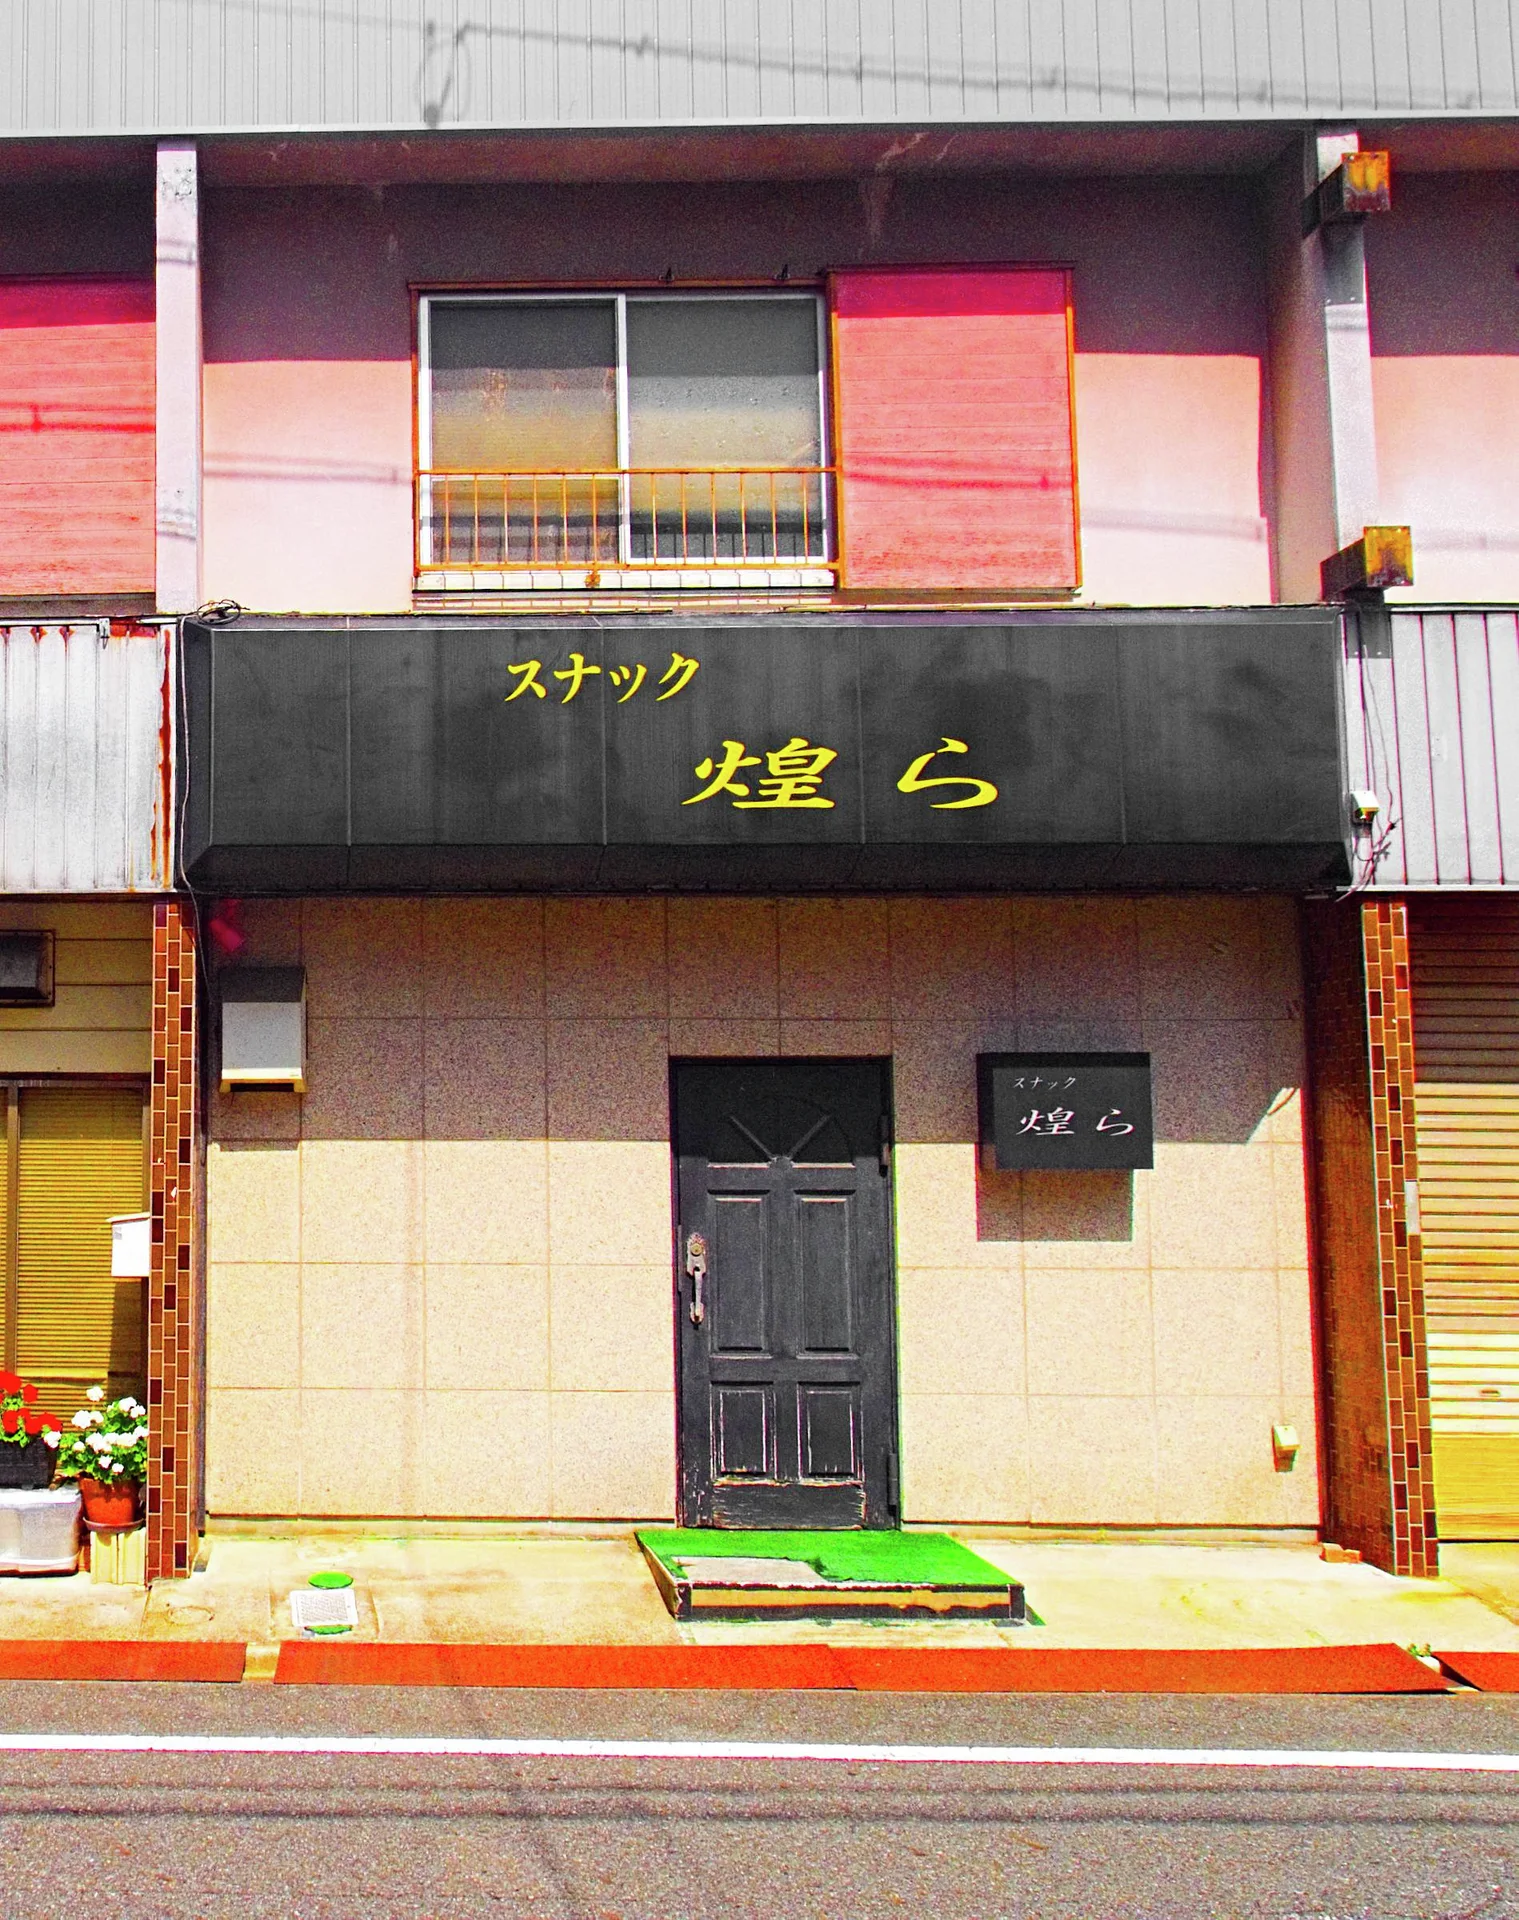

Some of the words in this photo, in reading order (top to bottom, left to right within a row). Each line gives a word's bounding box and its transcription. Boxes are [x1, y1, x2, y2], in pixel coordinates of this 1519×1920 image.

[504, 652, 700, 703] スナック
[681, 737, 999, 809] 煌ら
[1013, 1076, 1077, 1089] スナック
[1016, 1106, 1135, 1136] 煌ら
